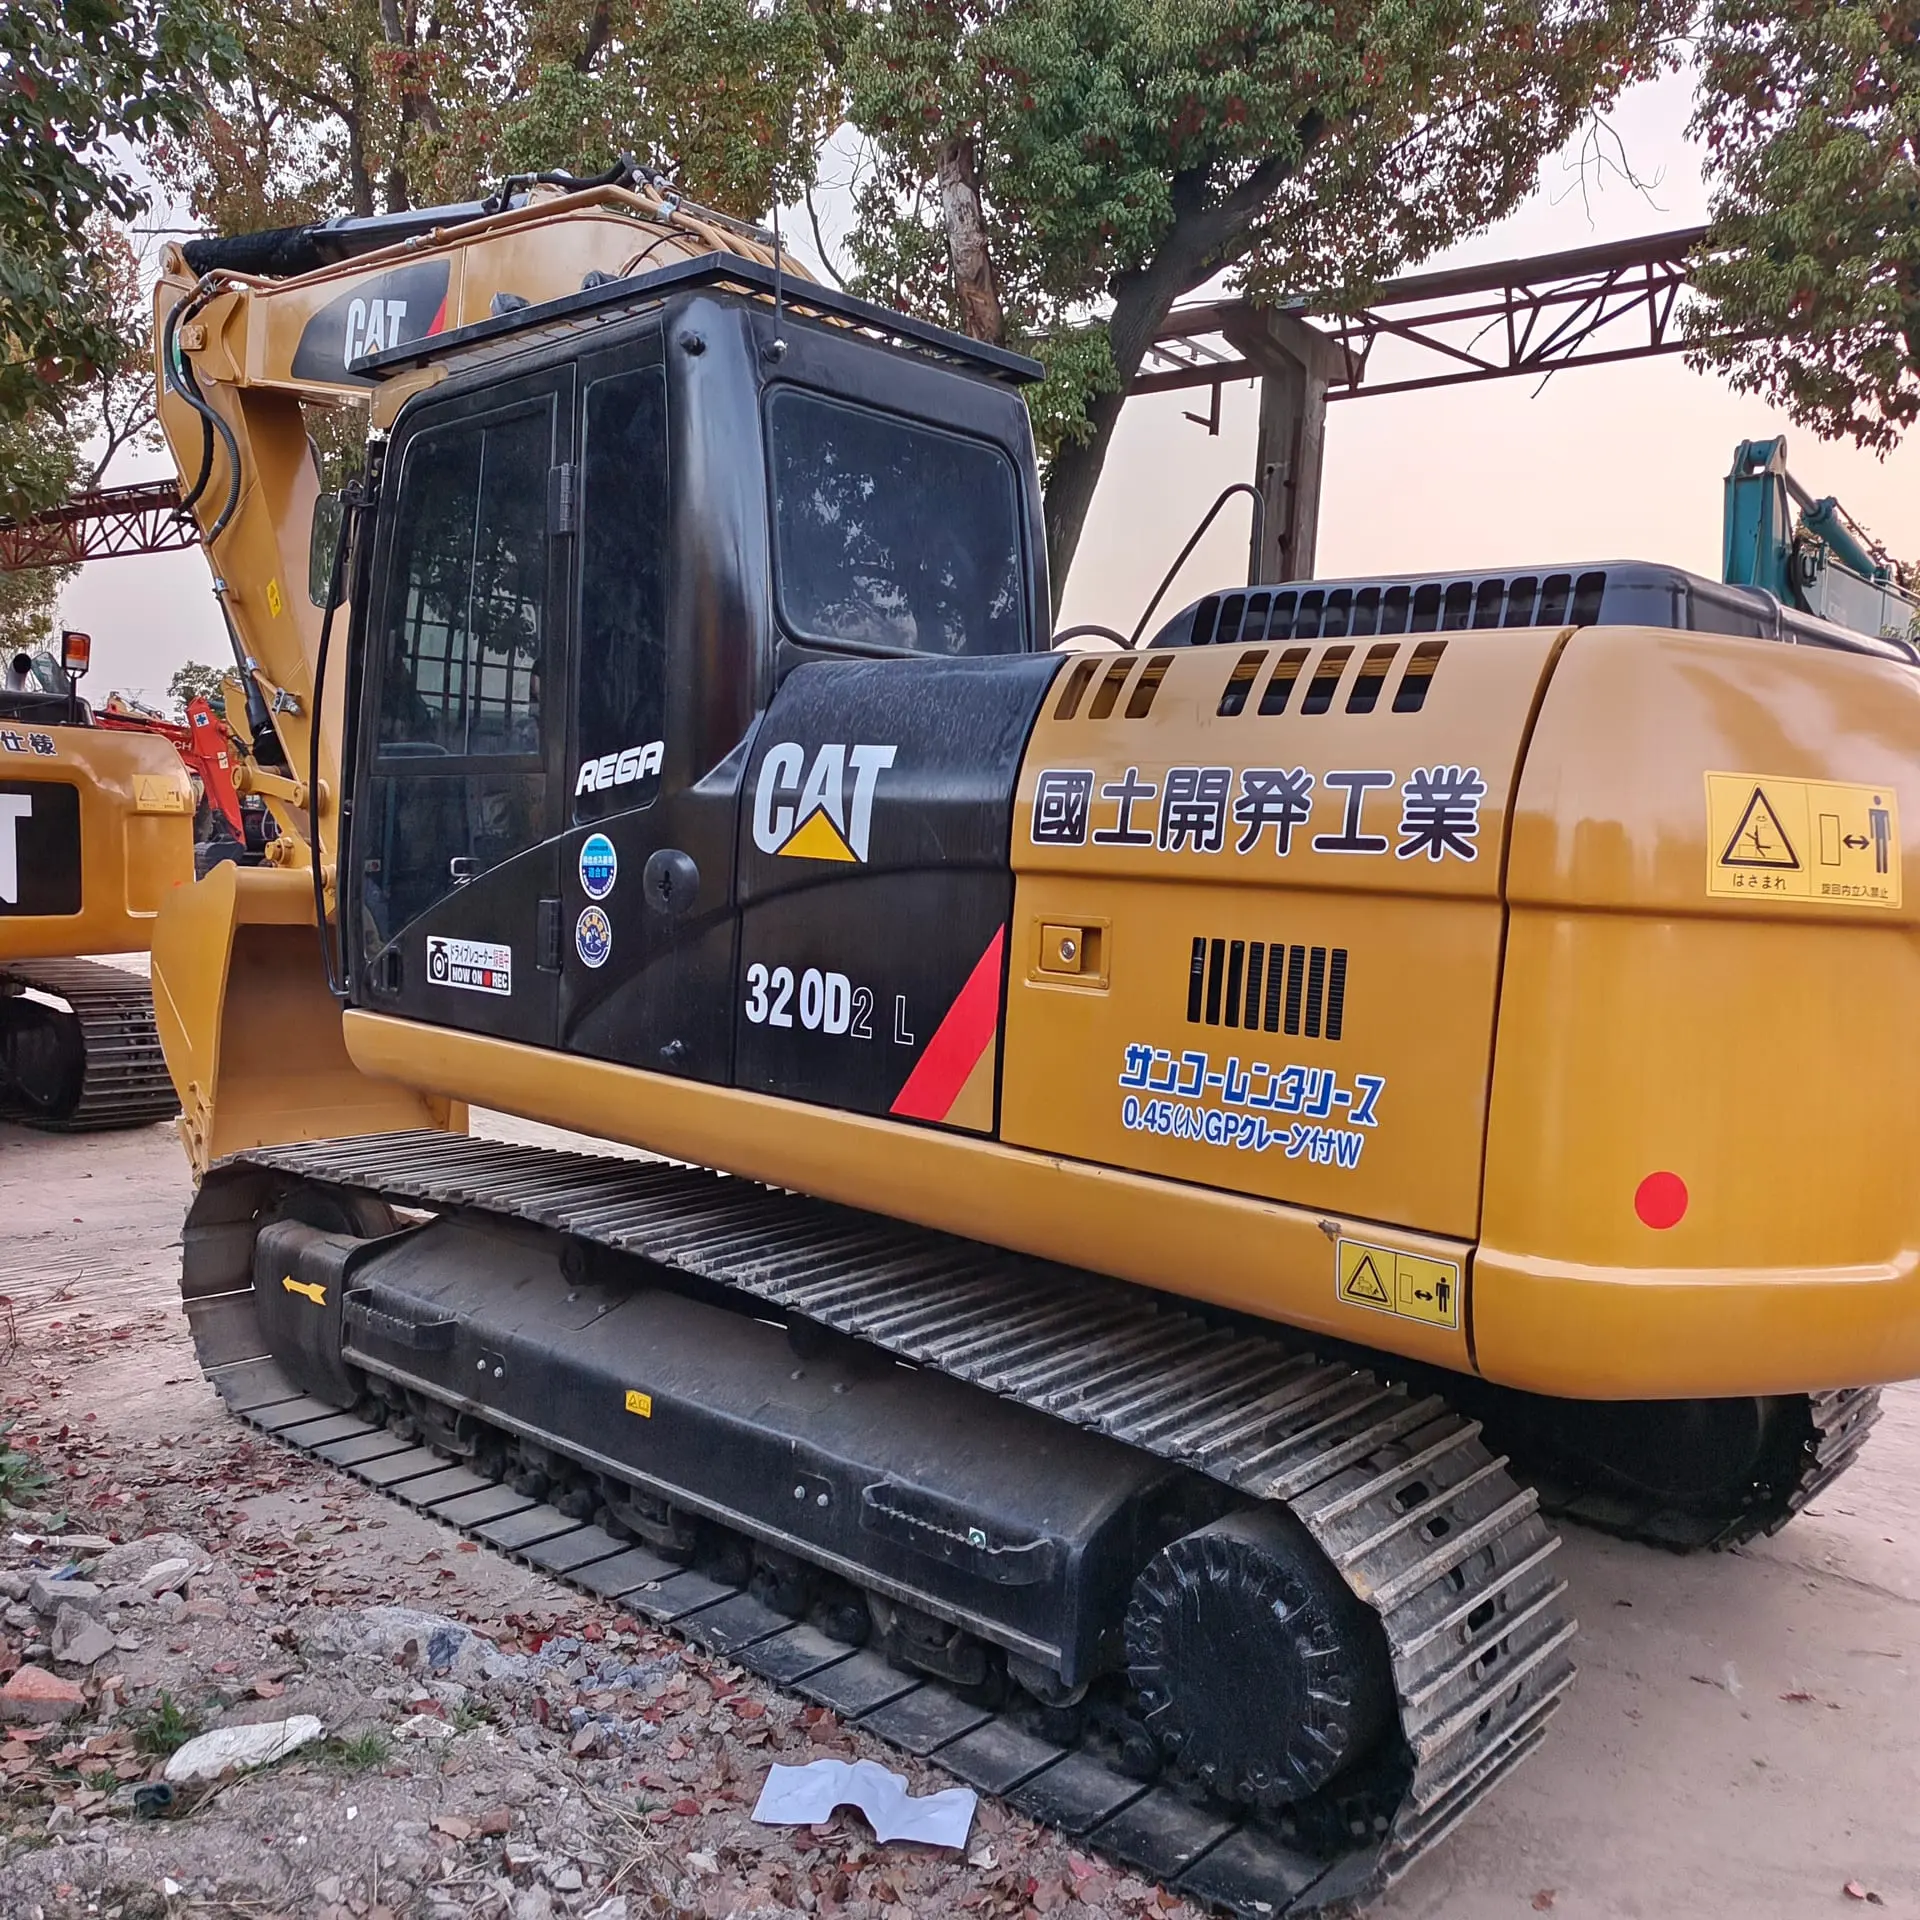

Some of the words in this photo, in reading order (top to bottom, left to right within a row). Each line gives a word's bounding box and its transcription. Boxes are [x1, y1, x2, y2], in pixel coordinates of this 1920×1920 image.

[344, 298, 407, 371] CAT
[752, 742, 898, 863] CAT
[1030, 766, 1488, 863] 國土開発工業
[1732, 873, 1788, 890] はさまれ
[452, 966, 471, 983] NOW
[472, 969, 483, 985] ON
[492, 971, 508, 989] REC
[1119, 1043, 1386, 1127] サンコーレンタリース
